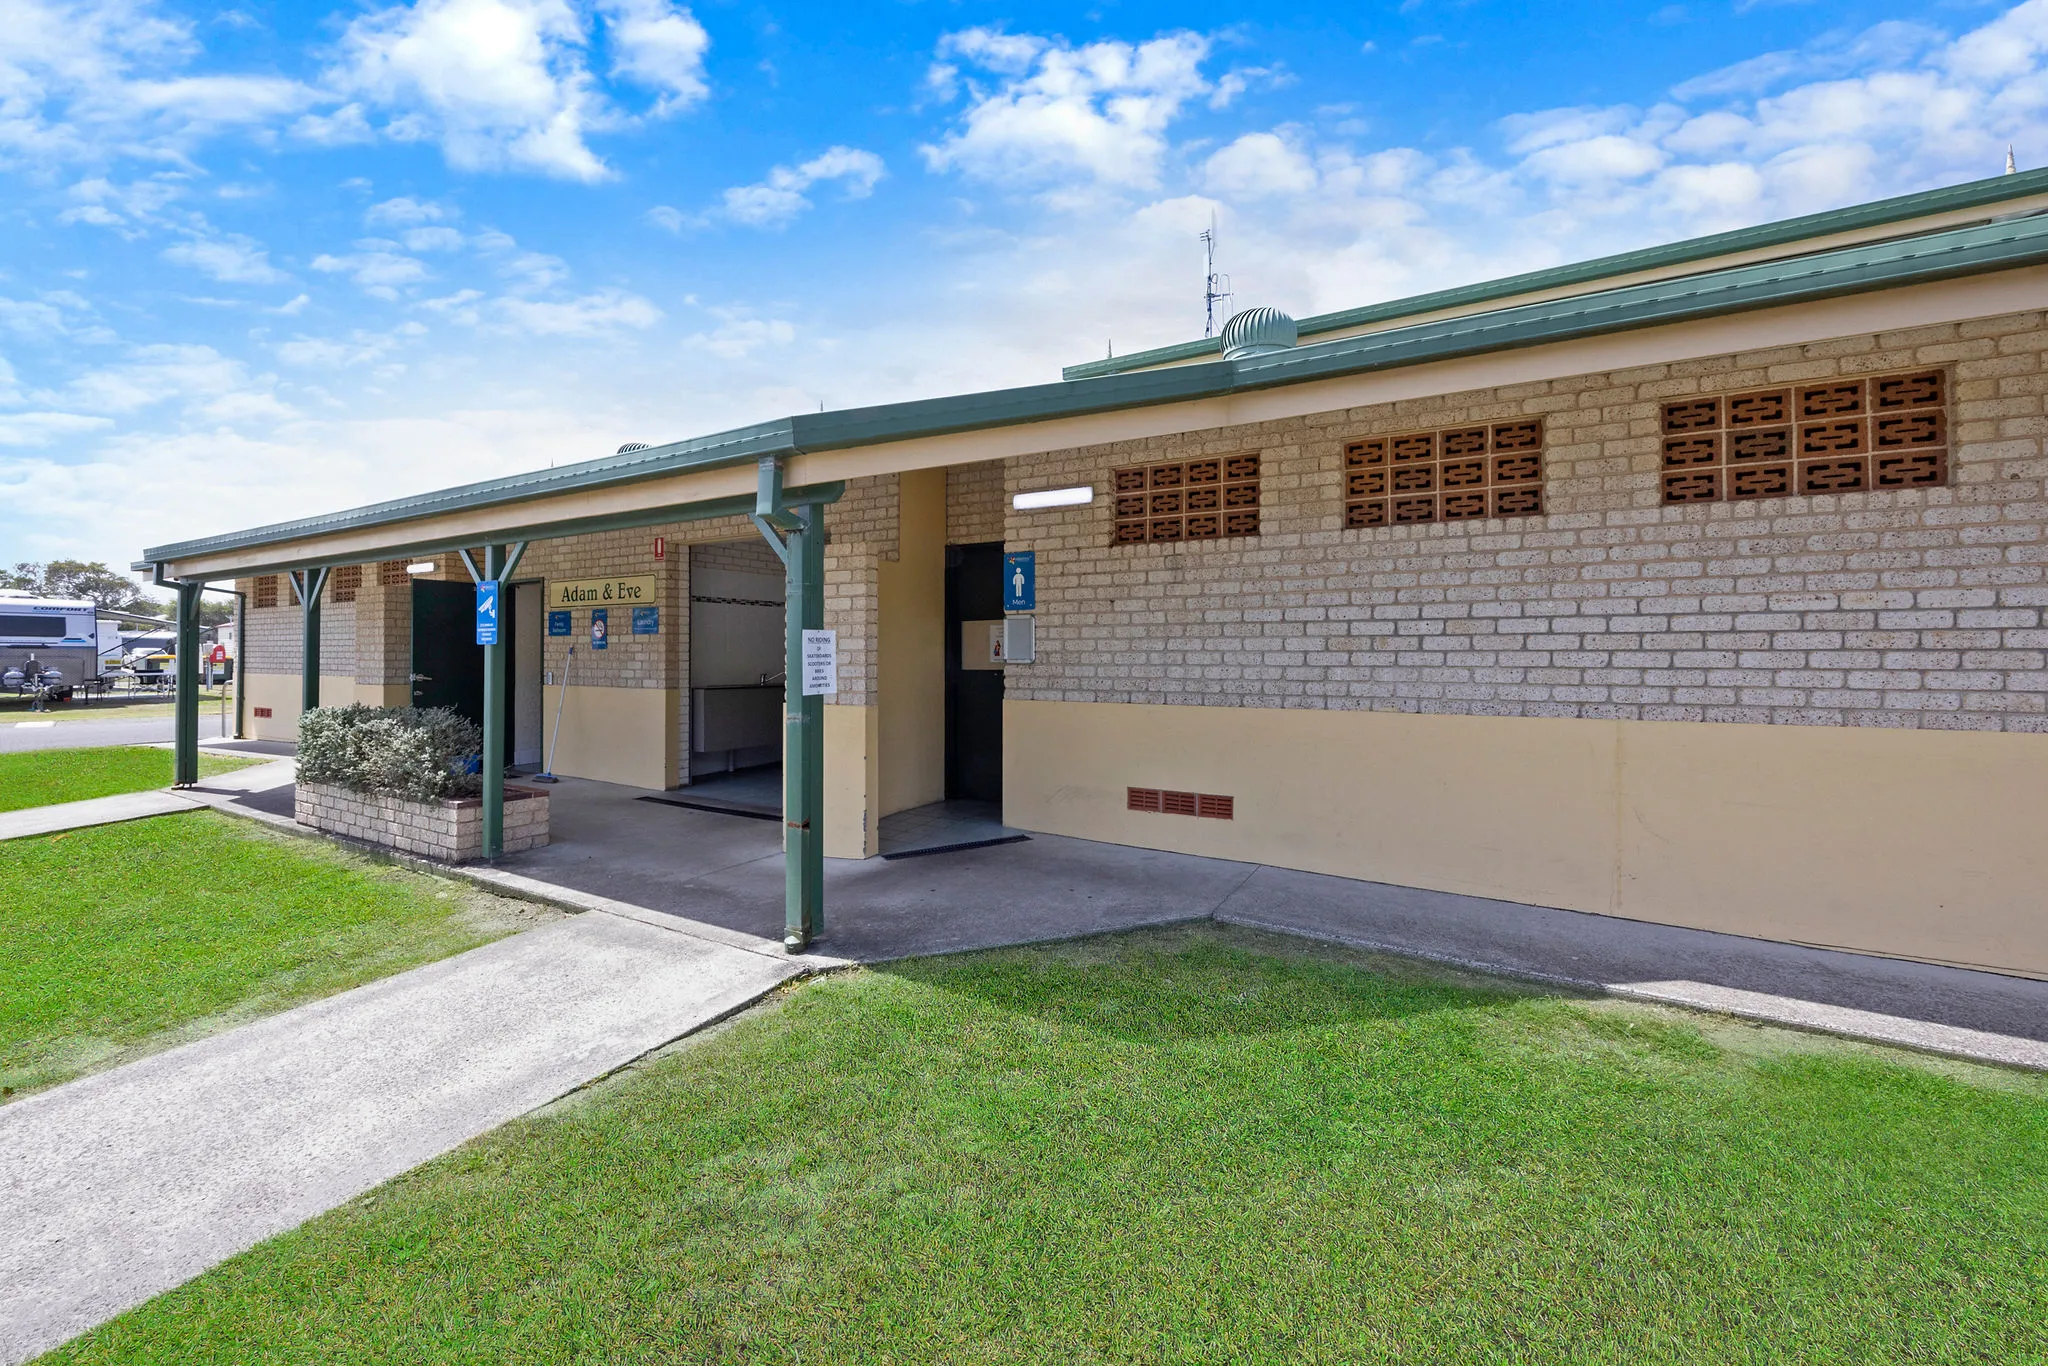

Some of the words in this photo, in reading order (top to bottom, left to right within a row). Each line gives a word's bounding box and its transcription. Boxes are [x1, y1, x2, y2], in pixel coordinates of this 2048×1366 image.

[561, 586, 598, 602] Adam
[602, 583, 613, 600] &
[617, 582, 641, 599] Eve
